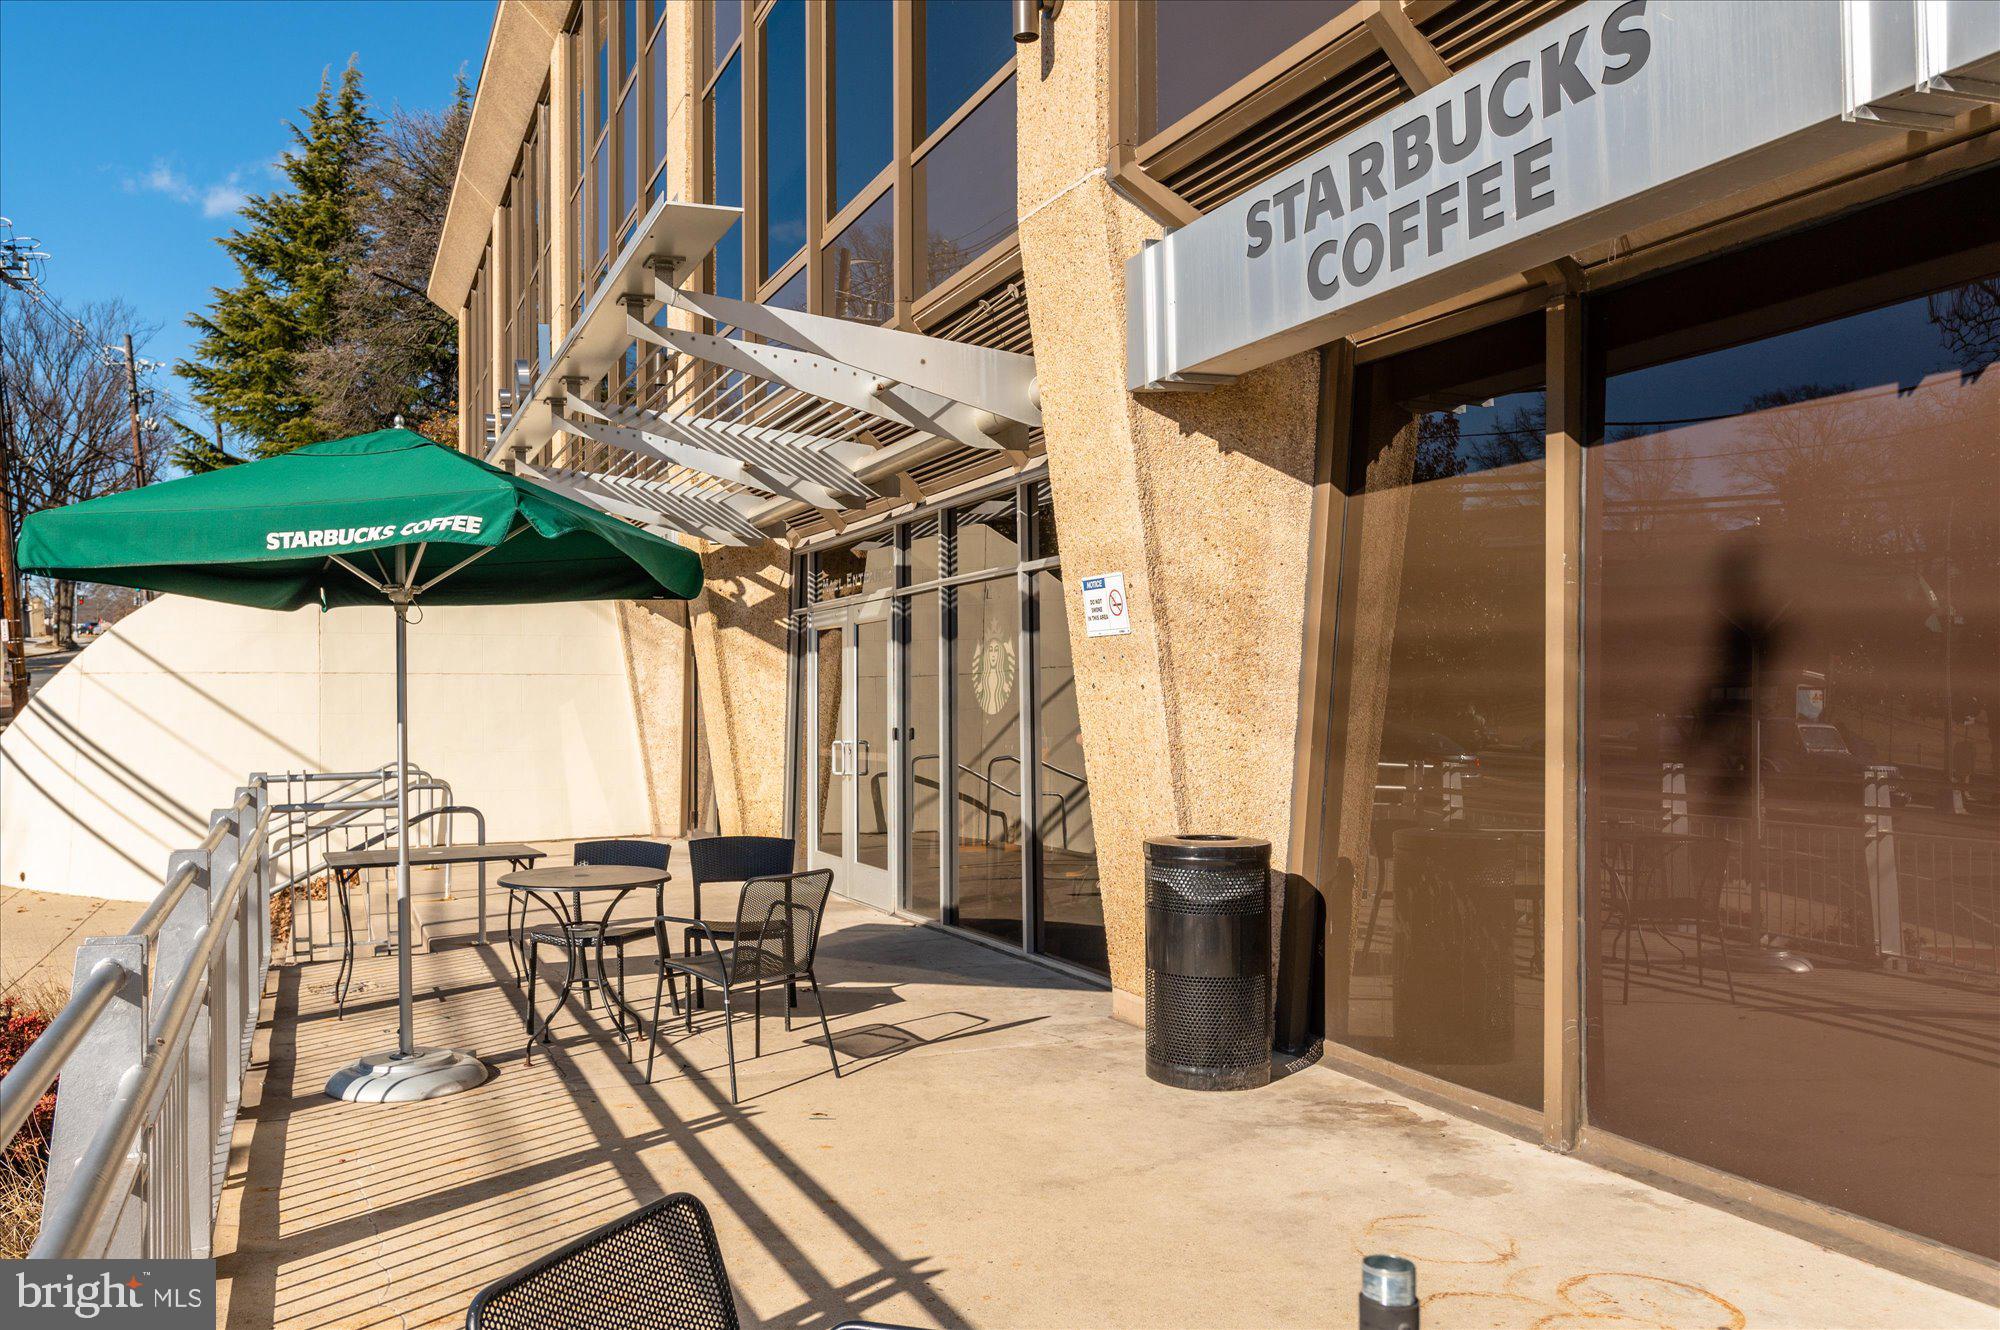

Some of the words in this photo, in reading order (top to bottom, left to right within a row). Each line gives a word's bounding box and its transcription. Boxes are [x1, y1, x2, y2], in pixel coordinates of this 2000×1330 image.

[1246, 0, 1651, 259] STARBUCKS
[1307, 138, 1555, 301] COFFEE
[266, 525, 396, 550] STARBUCKS
[400, 515, 483, 536] COFFEE
[1086, 580, 1103, 589] NOTICE
